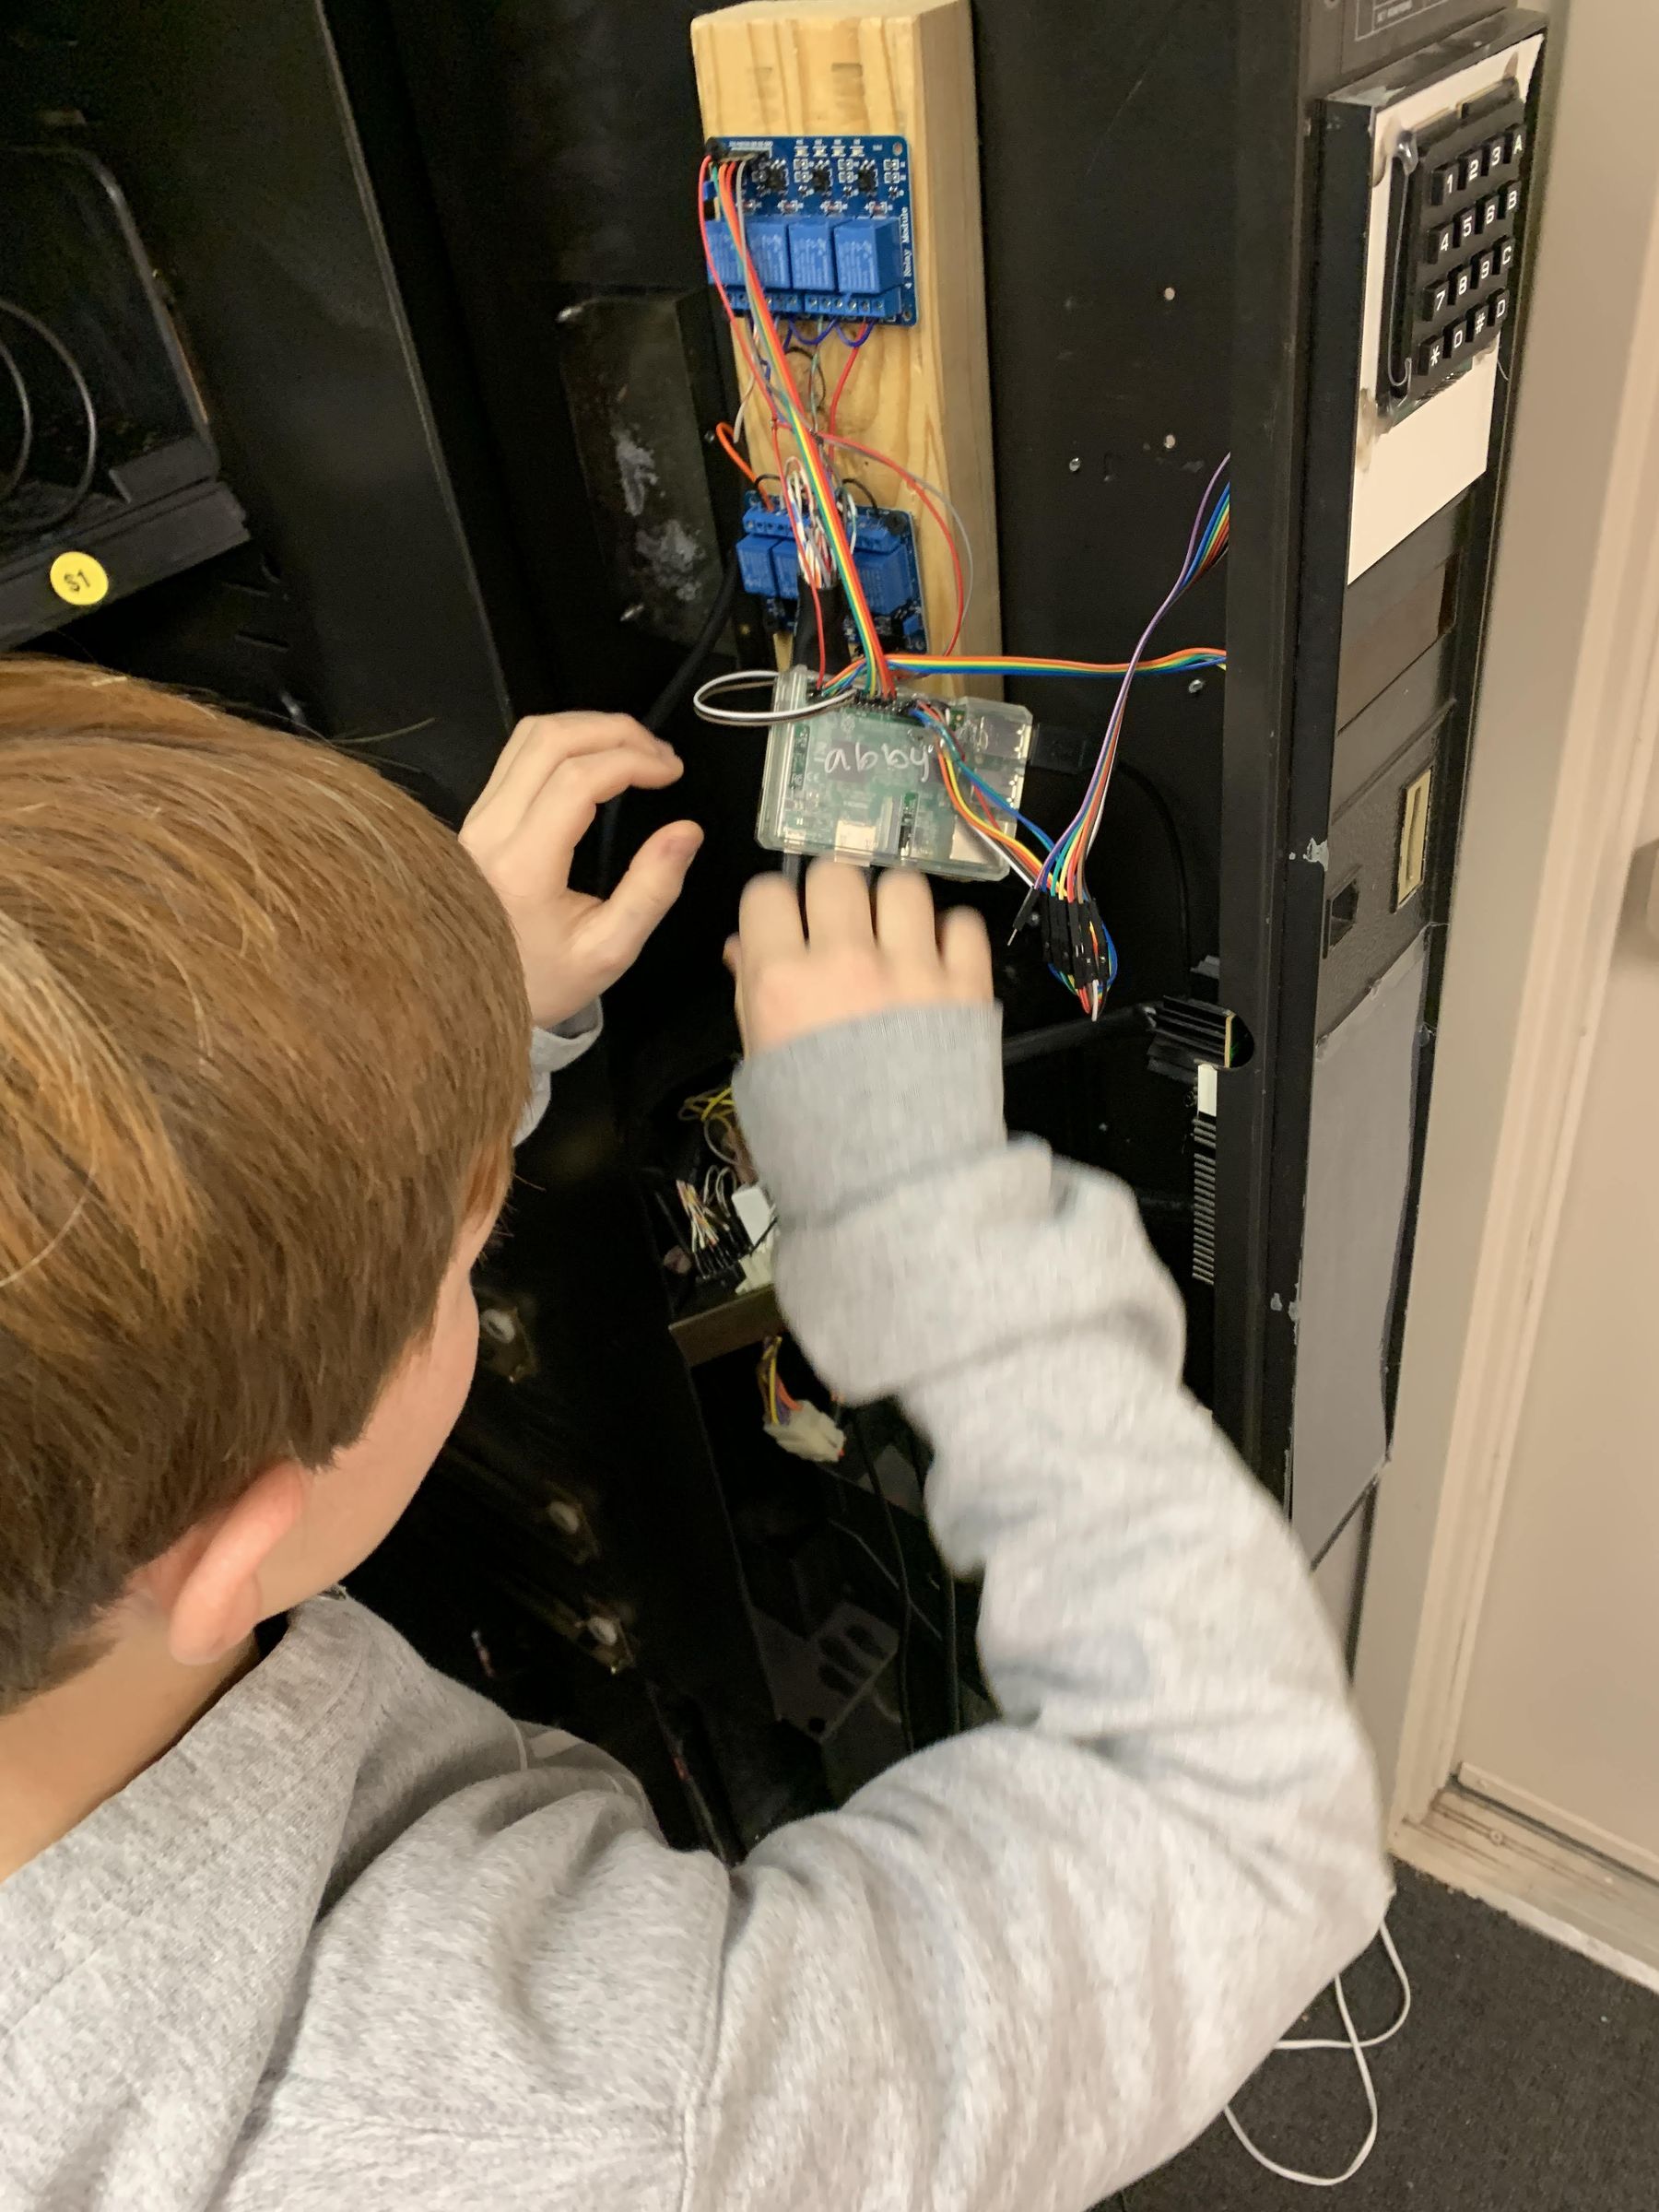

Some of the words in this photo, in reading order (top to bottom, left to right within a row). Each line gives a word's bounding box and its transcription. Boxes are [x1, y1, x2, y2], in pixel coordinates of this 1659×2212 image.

[1446, 173, 1453, 194] 1
[1468, 159, 1479, 182] 2
[1490, 146, 1501, 167] 3
[1512, 134, 1523, 155] A
[1440, 232, 1450, 252] 4
[1462, 216, 1473, 237] 5
[1485, 204, 1496, 225] 6
[1507, 190, 1518, 210] B
[1436, 289, 1446, 312] 7
[1458, 275, 1468, 296] 8
[1480, 260, 1490, 279] 9
[1501, 245, 1512, 265] C
[1475, 312, 1486, 335] #
[1496, 298, 1507, 318] D
